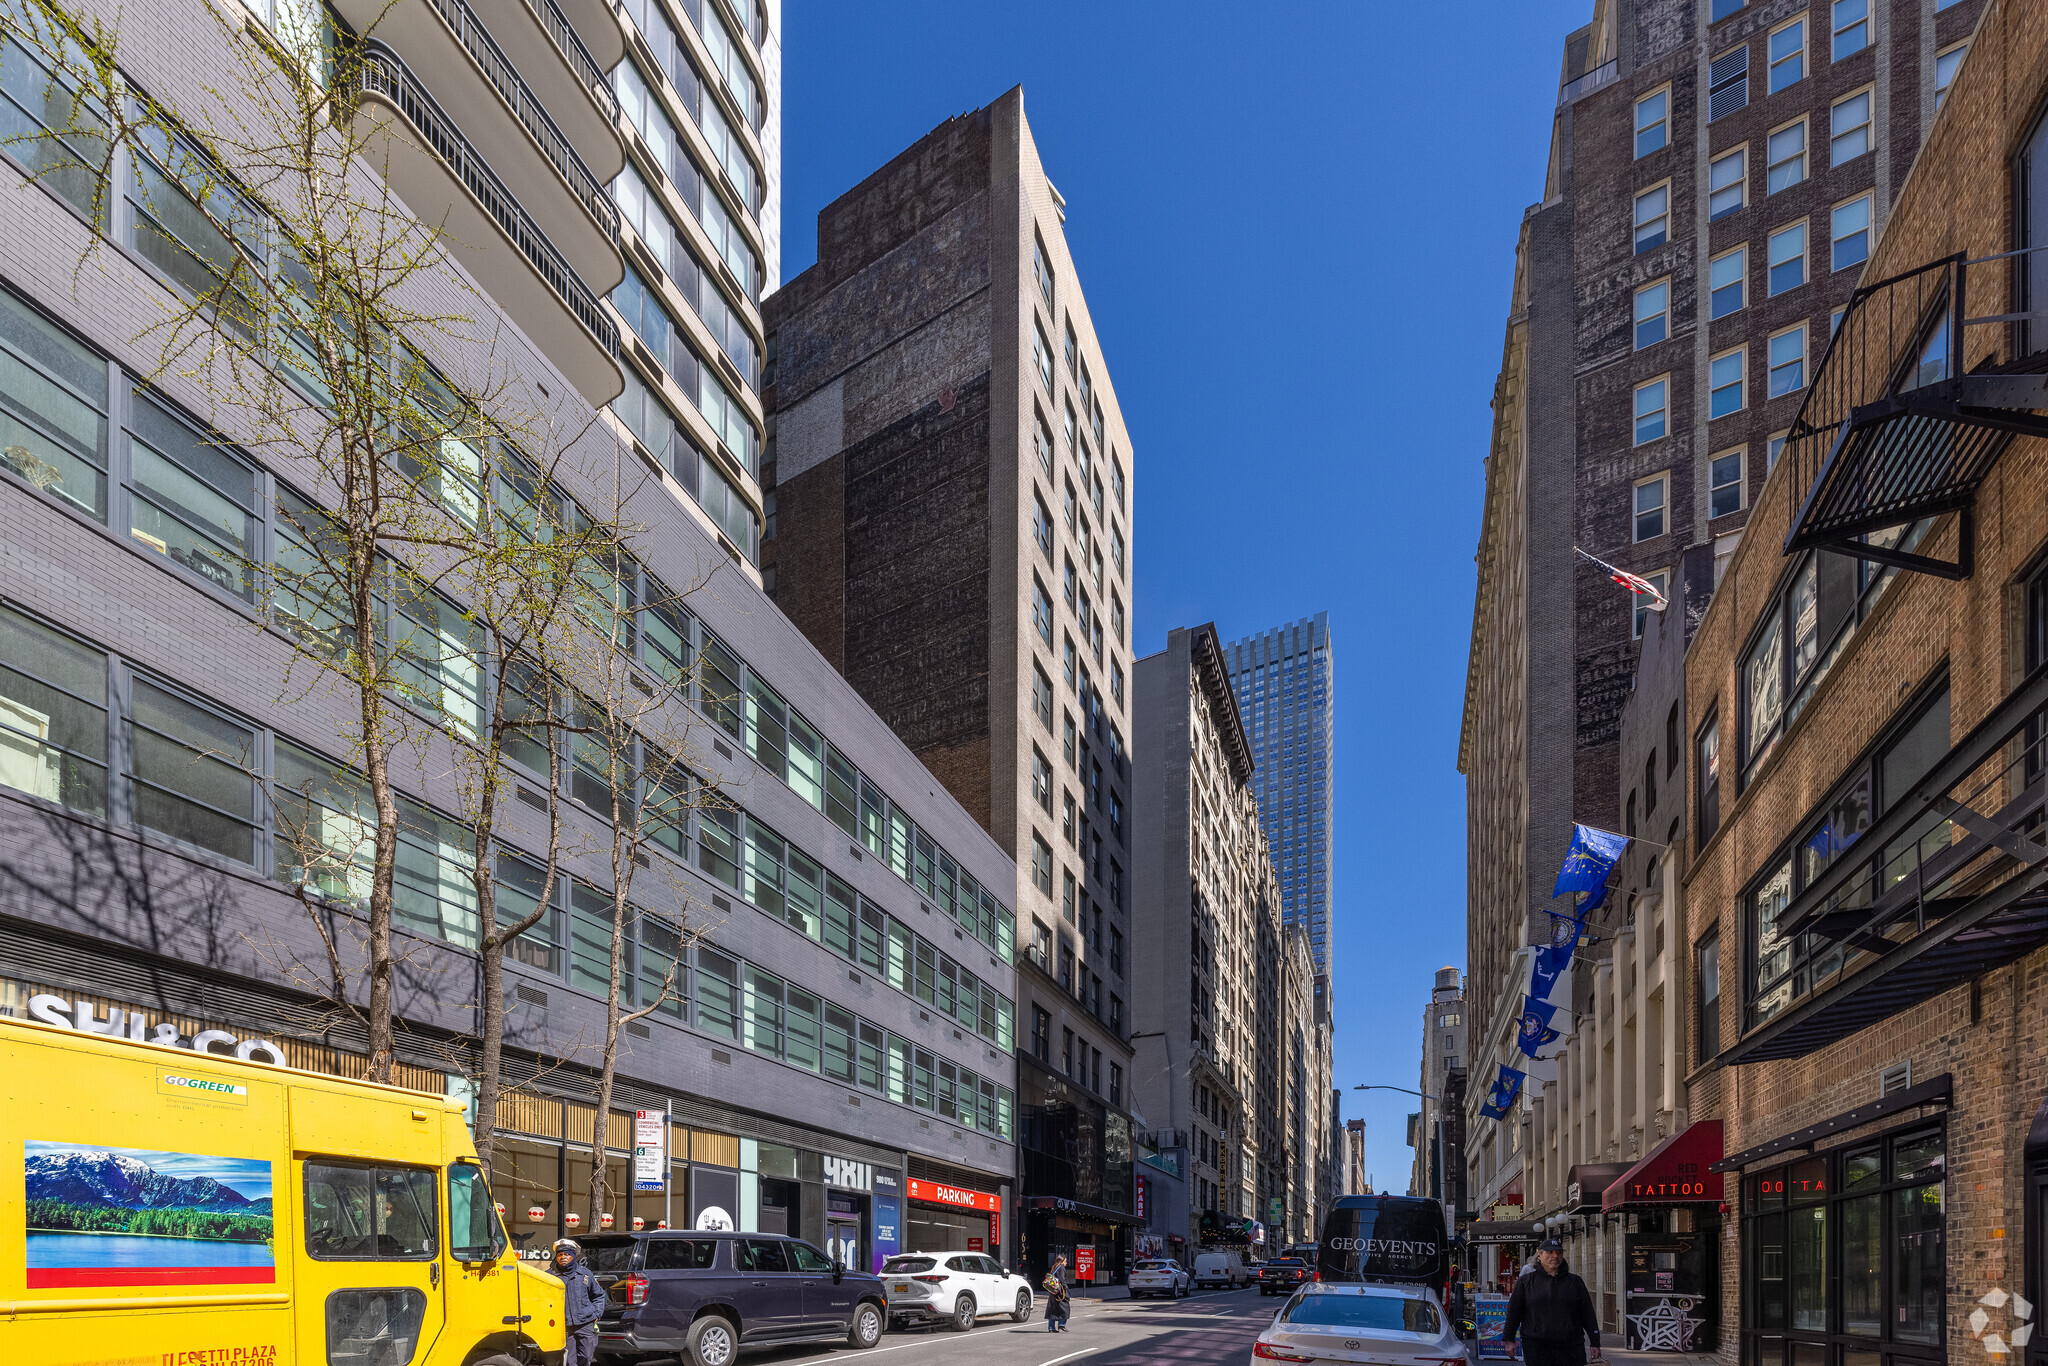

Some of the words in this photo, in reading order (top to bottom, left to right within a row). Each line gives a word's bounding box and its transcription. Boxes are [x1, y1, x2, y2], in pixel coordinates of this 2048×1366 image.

[165, 1075, 235, 1094] GOGREEN
[639, 1111, 645, 1119] 3
[1678, 1163, 1698, 1174] RED
[937, 1186, 975, 1206] PARKING
[1634, 1182, 1704, 1196] TATTOO
[1330, 1237, 1436, 1256] GEOEVENTS
[233, 1345, 276, 1360] PLAZA
